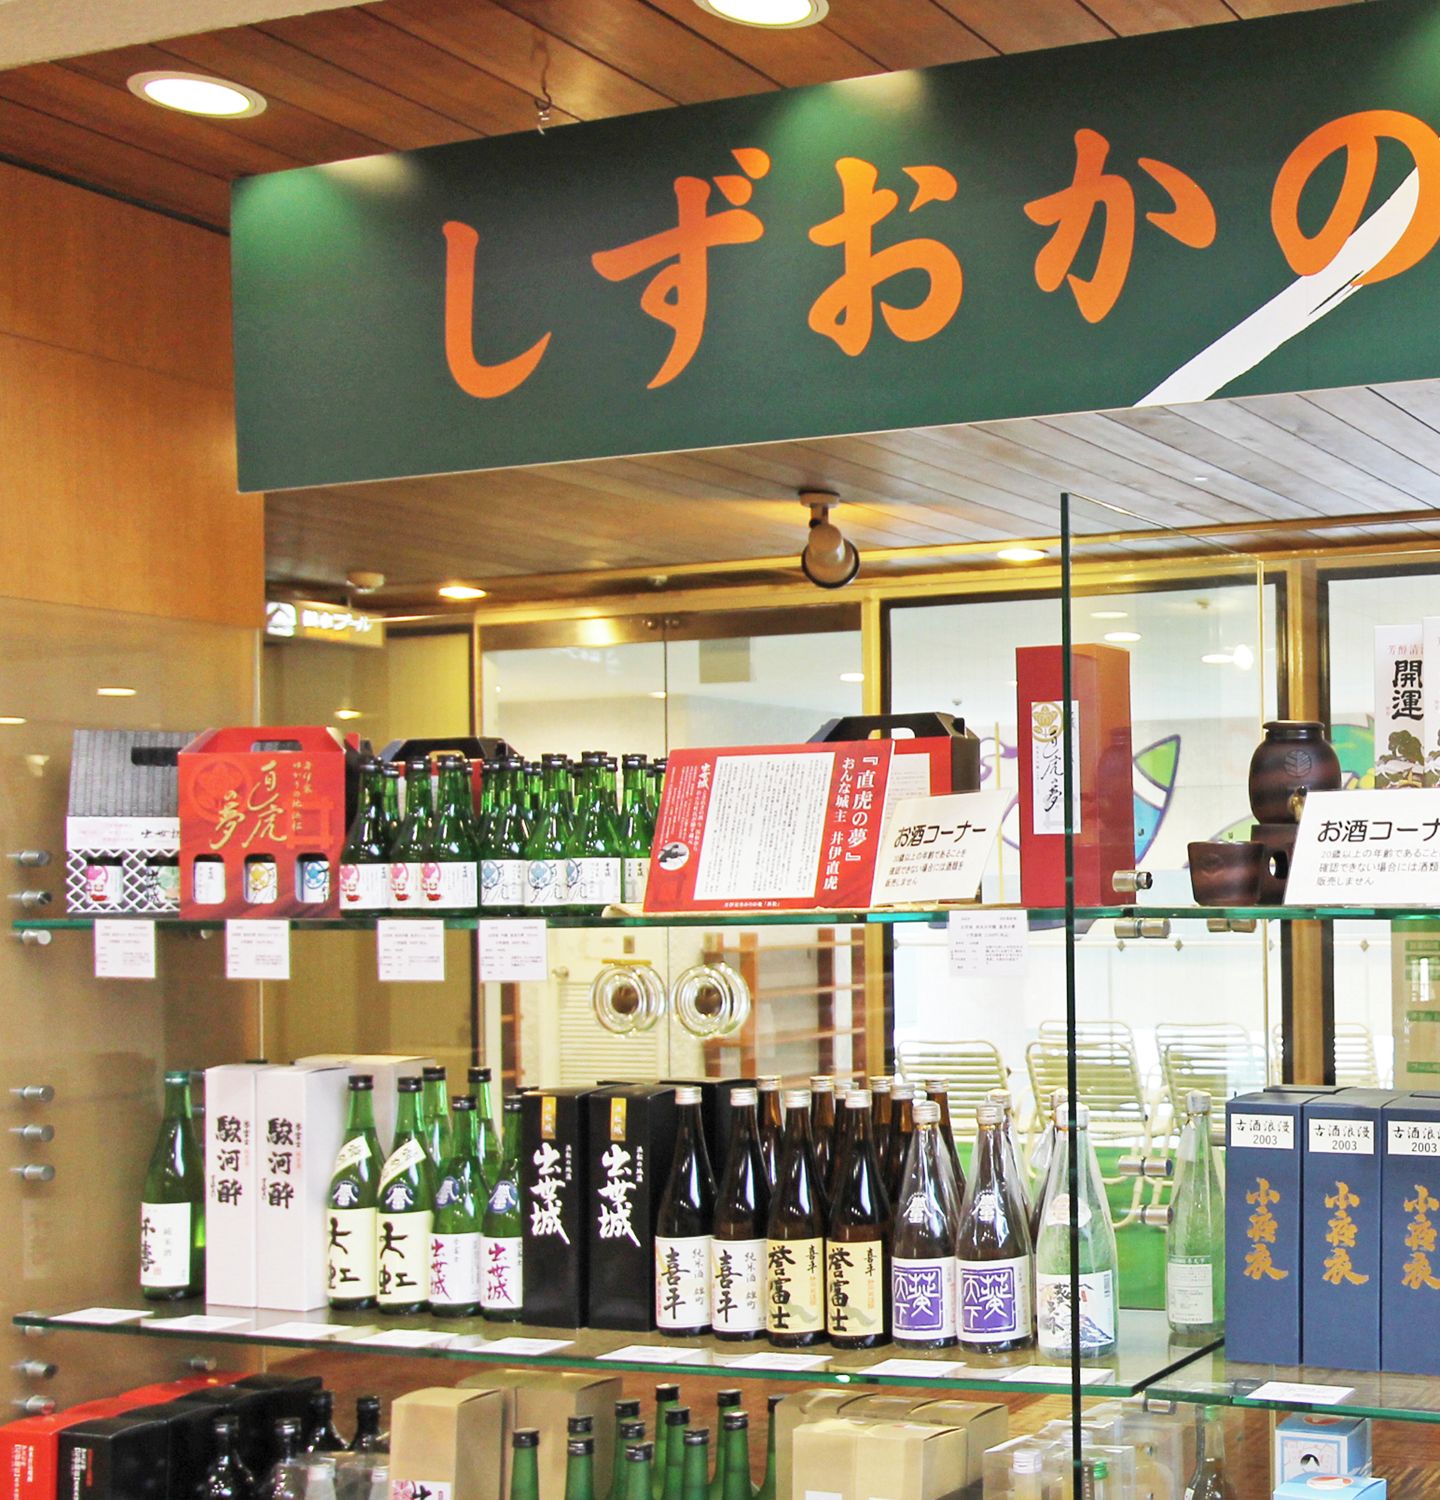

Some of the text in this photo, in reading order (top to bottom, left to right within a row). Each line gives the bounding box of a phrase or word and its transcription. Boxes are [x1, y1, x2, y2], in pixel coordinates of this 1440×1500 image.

[1388, 644, 1424, 655] 芳醇清
[1391, 660, 1424, 721] 開運
[823, 757, 855, 890] おんな城主 井伊直虎
[845, 756, 878, 862] 『直虎の夢』
[894, 820, 986, 848] お酒コーナー
[216, 1115, 242, 1206] 駿河酔
[267, 1118, 294, 1209] 駿河酔
[1253, 1134, 1278, 1146] 2003
[1332, 1140, 1357, 1151] 2003
[1411, 1142, 1438, 1153] 2003
[530, 1142, 571, 1245] 出世城
[597, 1144, 642, 1247] 出世城
[661, 1247, 691, 1320] 喜平
[715, 1249, 743, 1323] 喜平
[768, 1245, 796, 1329] 誉富士
[828, 1247, 854, 1332] 誉富士
